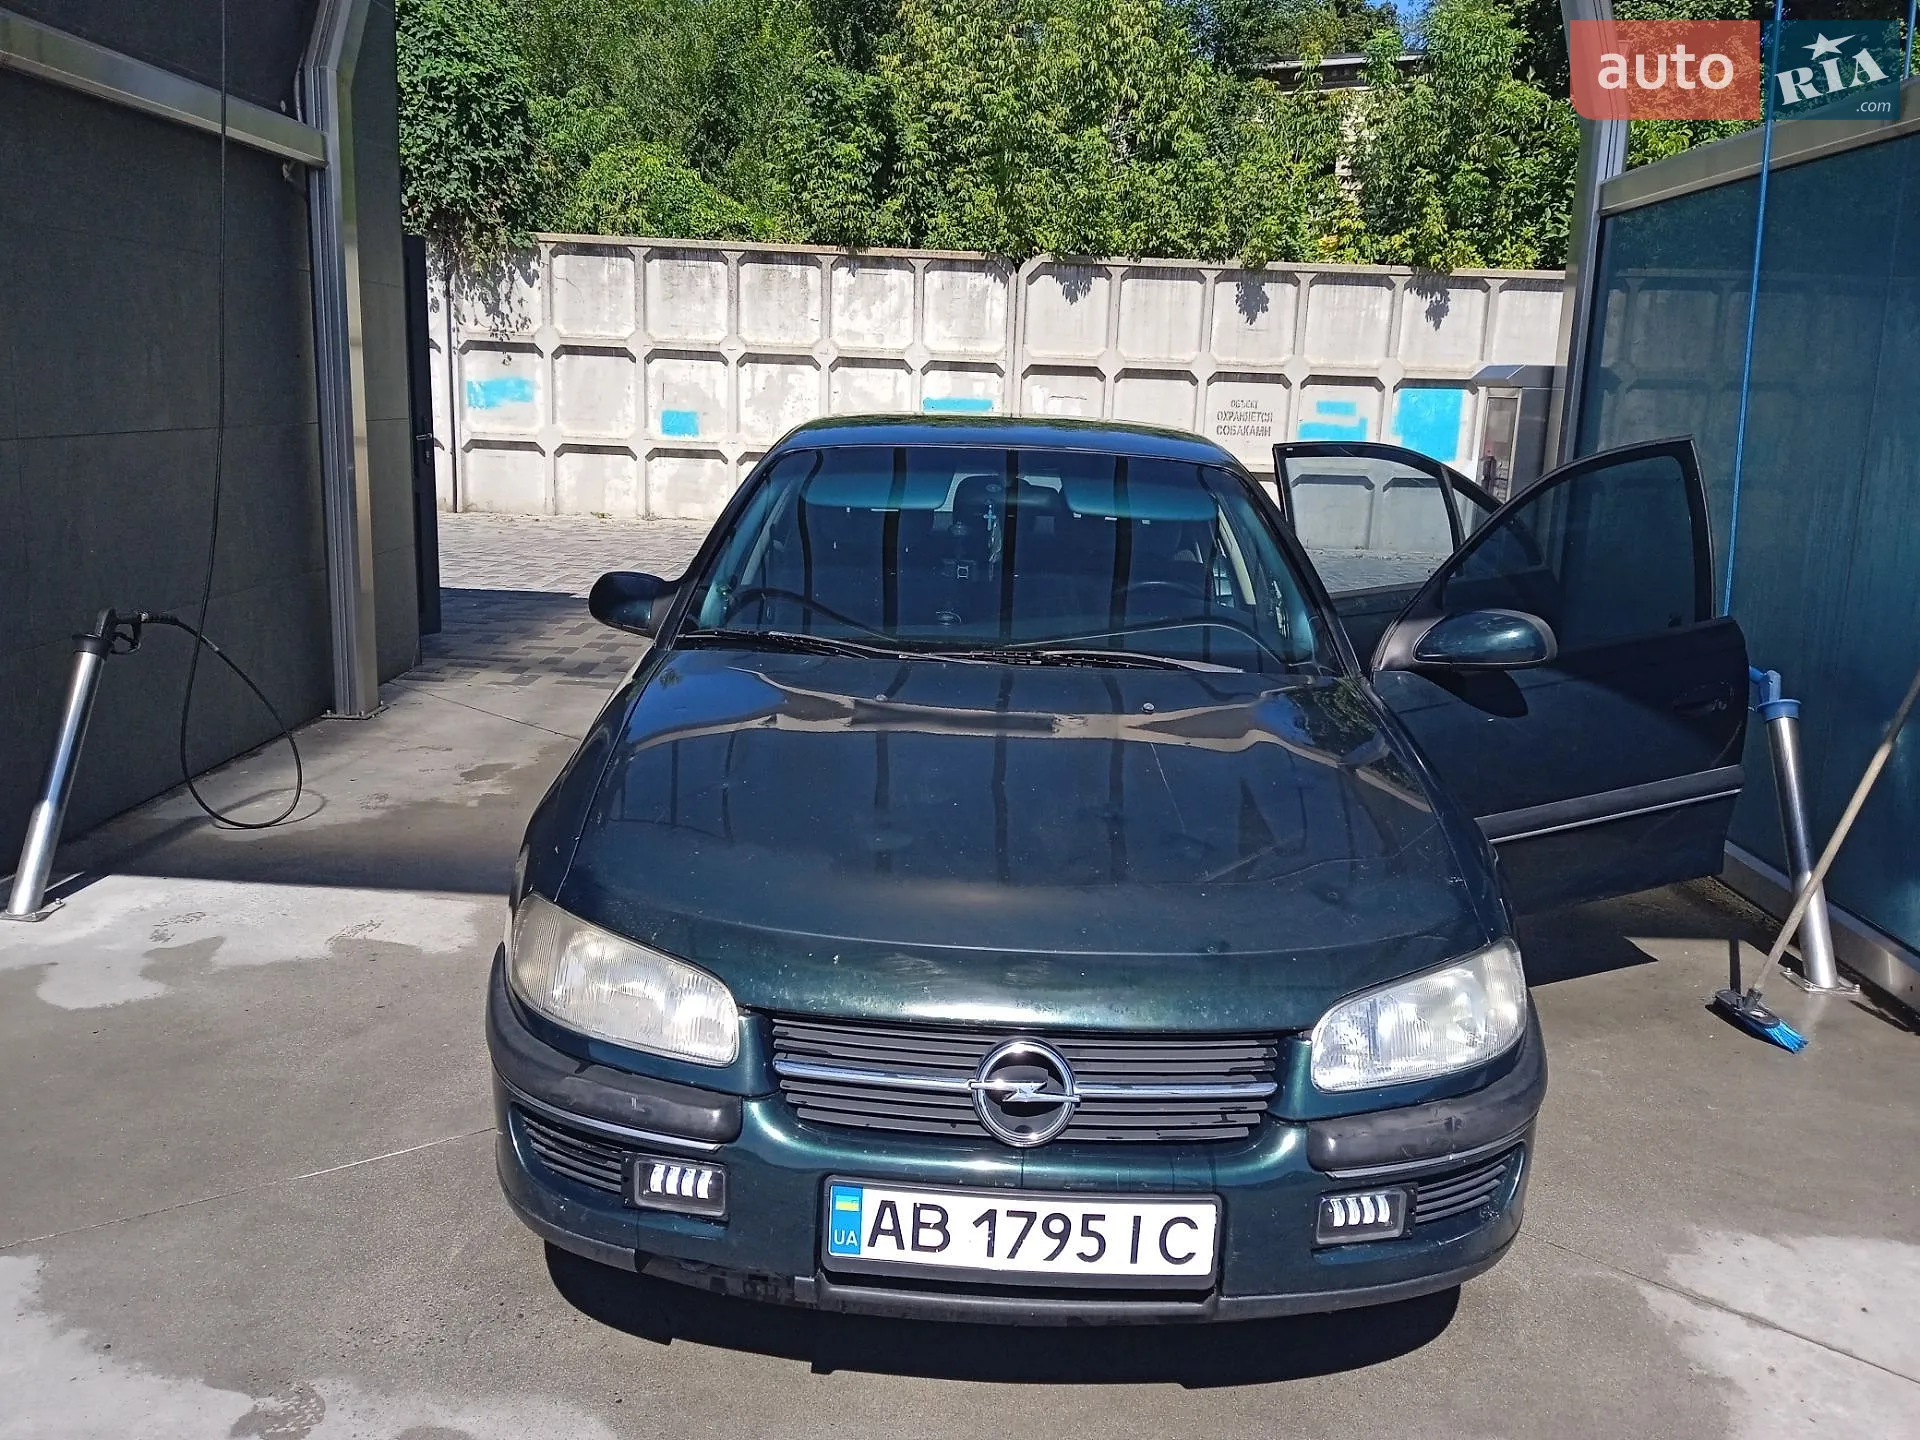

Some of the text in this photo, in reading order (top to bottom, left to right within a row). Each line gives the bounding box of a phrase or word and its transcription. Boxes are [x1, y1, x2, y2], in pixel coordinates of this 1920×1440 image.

[833, 1230, 858, 1246] UA
[867, 1200, 951, 1253] AB
[972, 1208, 1106, 1263] 1795
